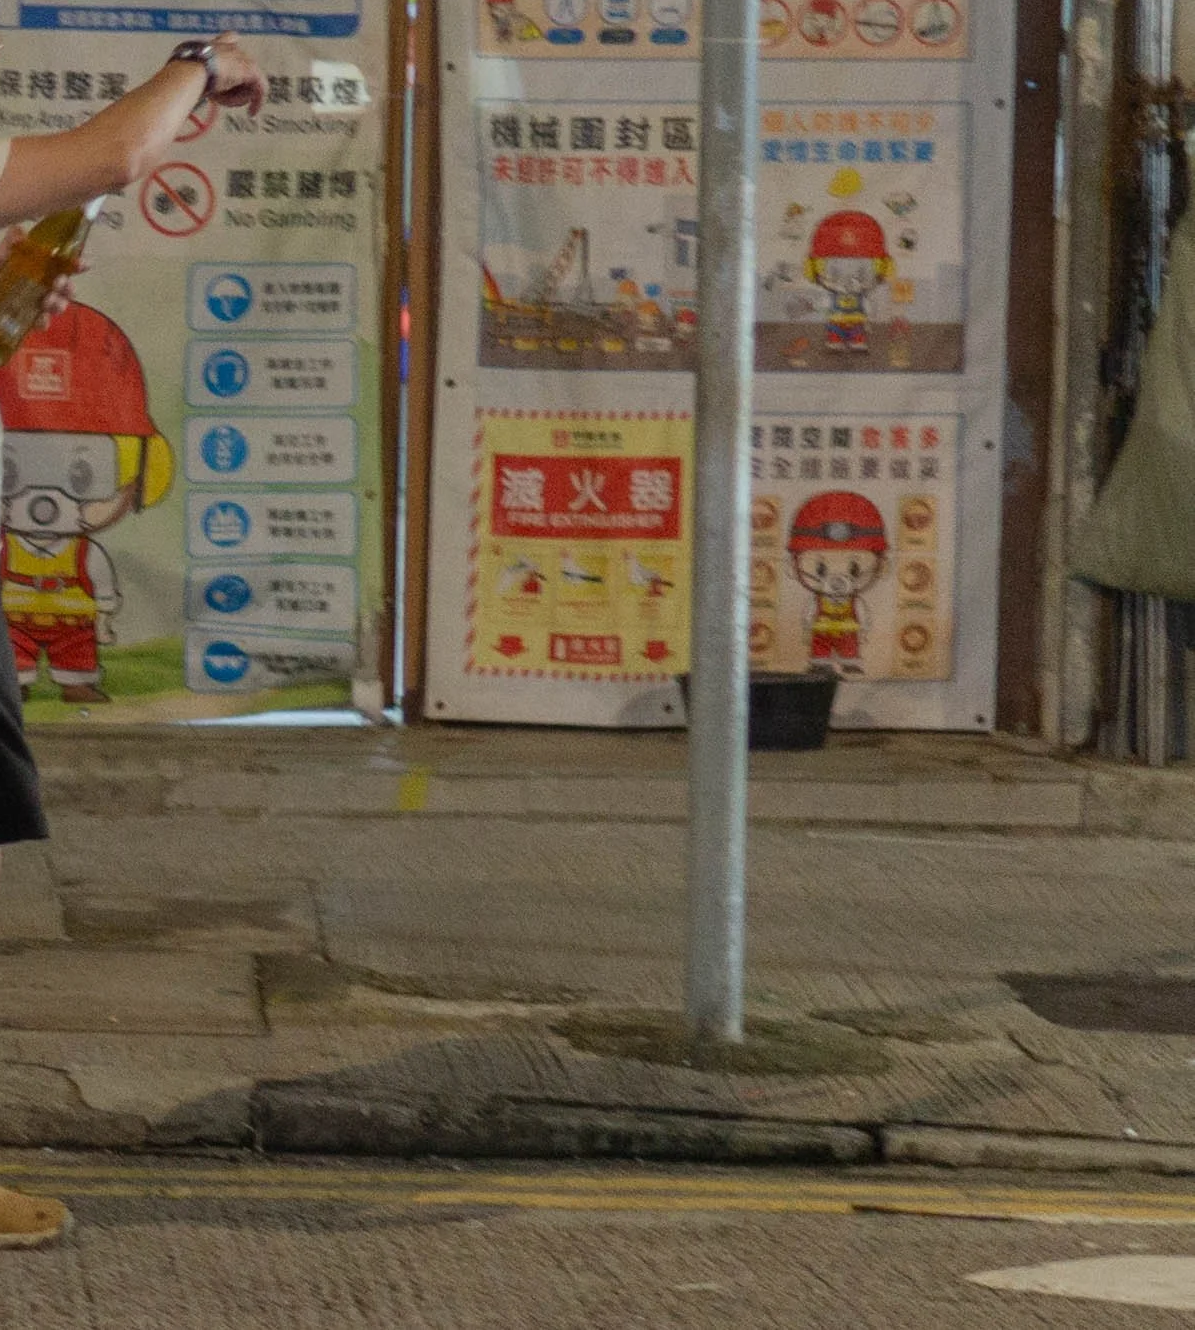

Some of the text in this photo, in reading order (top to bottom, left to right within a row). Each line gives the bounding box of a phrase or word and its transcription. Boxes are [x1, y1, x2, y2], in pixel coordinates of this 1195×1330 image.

[267, 74, 360, 105] 禁吸煙
[226, 114, 359, 138] No Smoking
[492, 155, 696, 186] 未經許可不得進入
[224, 208, 255, 229] No
[500, 466, 673, 513] 滅火器
